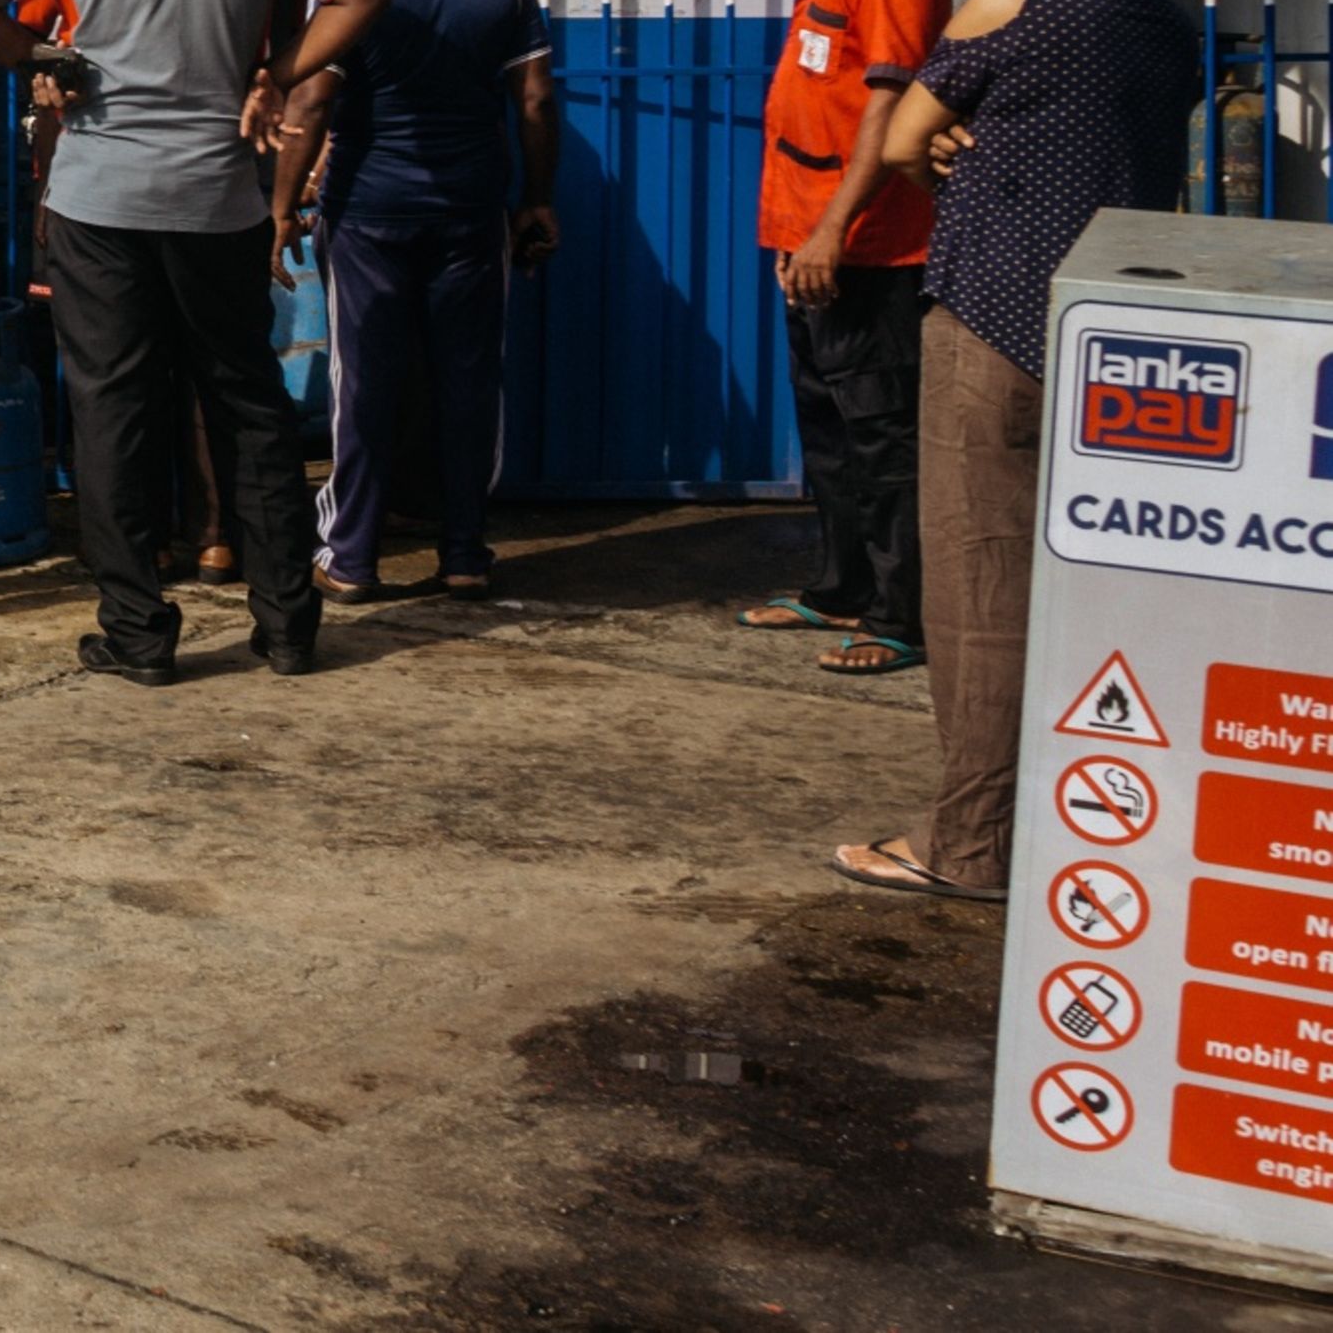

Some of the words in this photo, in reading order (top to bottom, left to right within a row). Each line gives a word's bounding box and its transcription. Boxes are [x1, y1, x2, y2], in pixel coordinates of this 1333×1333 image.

[1088, 342, 1237, 396] lanka
[1083, 383, 1236, 456] pay
[1066, 494, 1226, 546] CARDS
[1215, 719, 1304, 756] Highly
[1231, 940, 1309, 969] open
[1205, 1039, 1310, 1075] mobile
[1235, 1115, 1333, 1155] Switch
